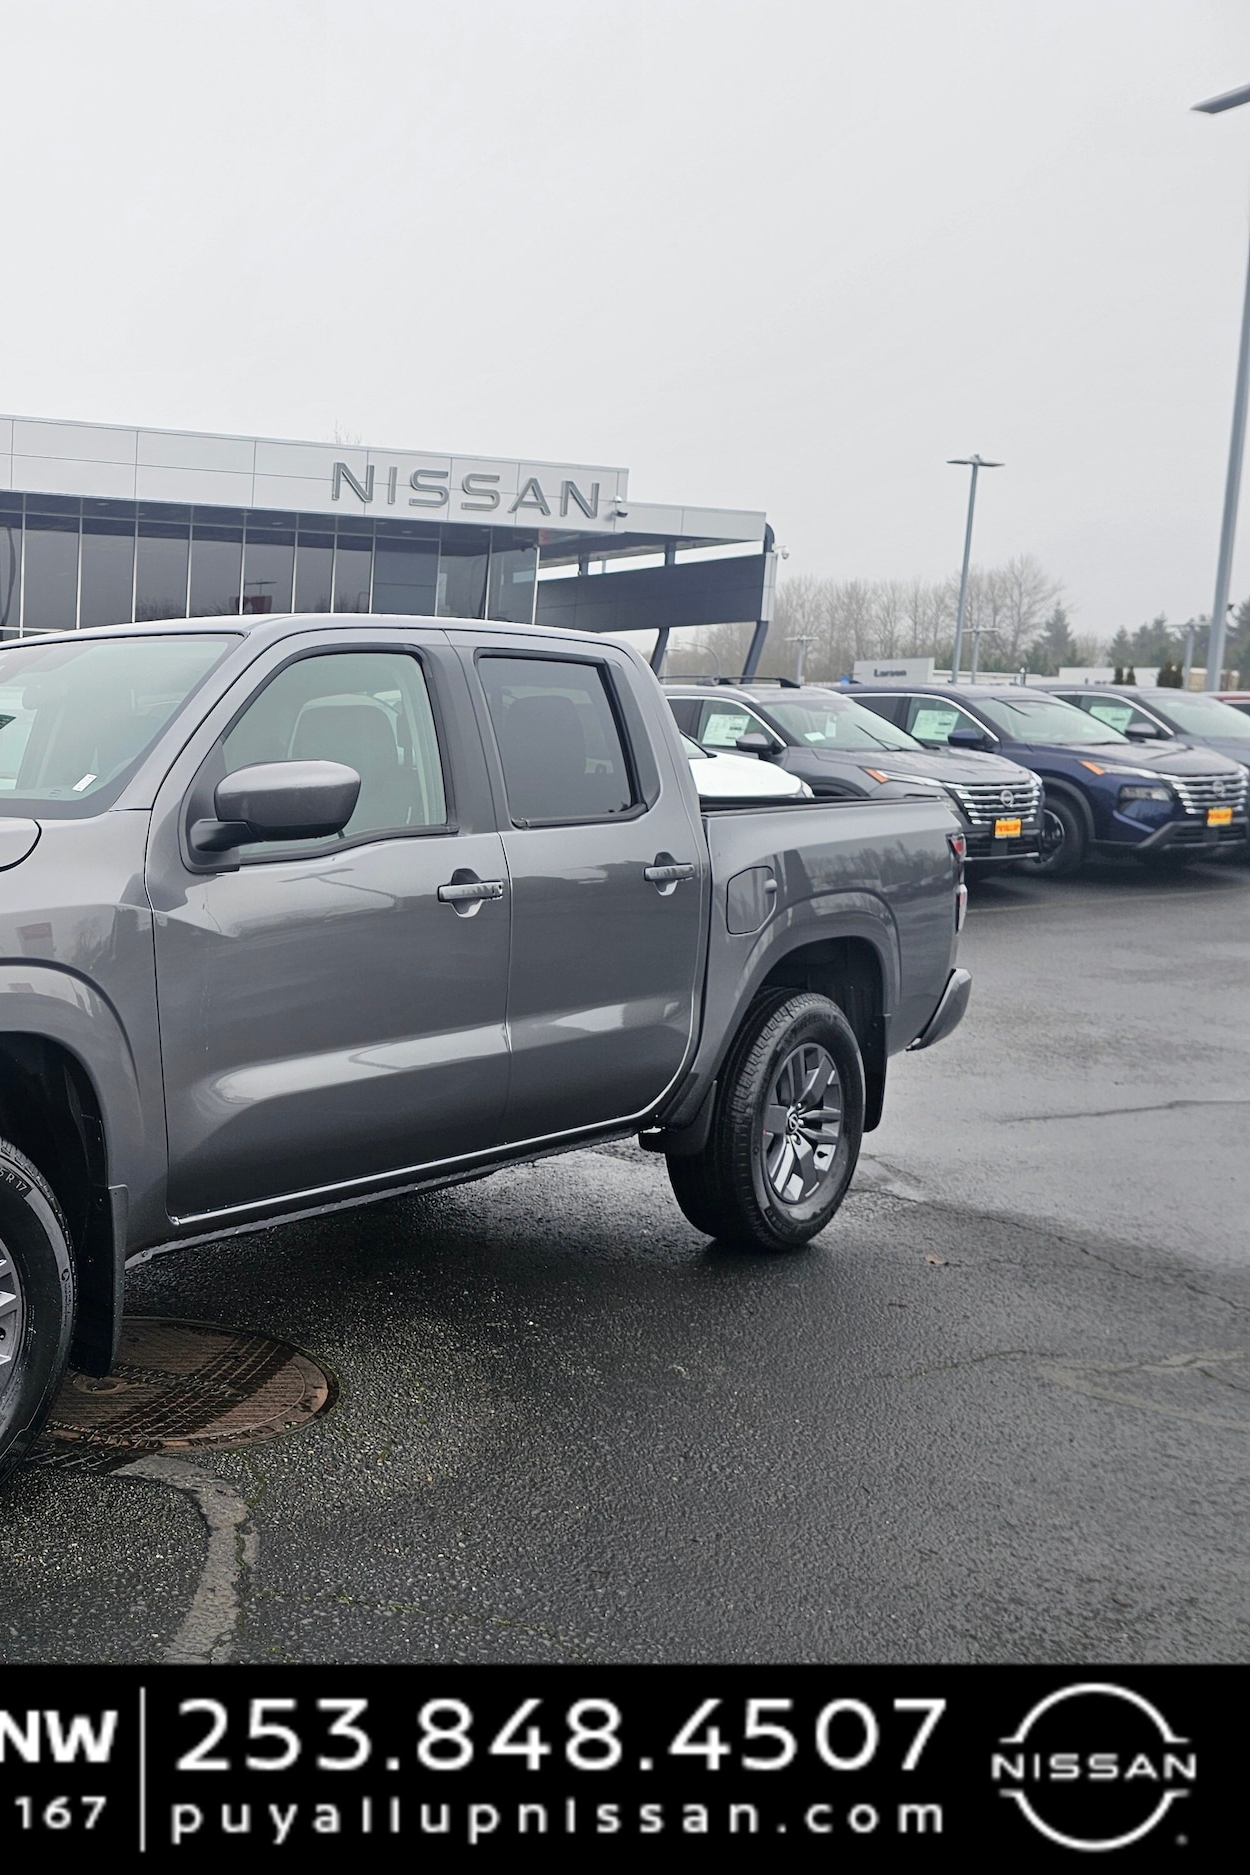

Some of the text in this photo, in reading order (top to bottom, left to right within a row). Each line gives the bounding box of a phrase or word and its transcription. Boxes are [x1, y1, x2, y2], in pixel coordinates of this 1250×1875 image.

[331, 462, 600, 519] NISSAN
[5, 1173, 16, 1185] R
[15, 1179, 29, 1194] 17
